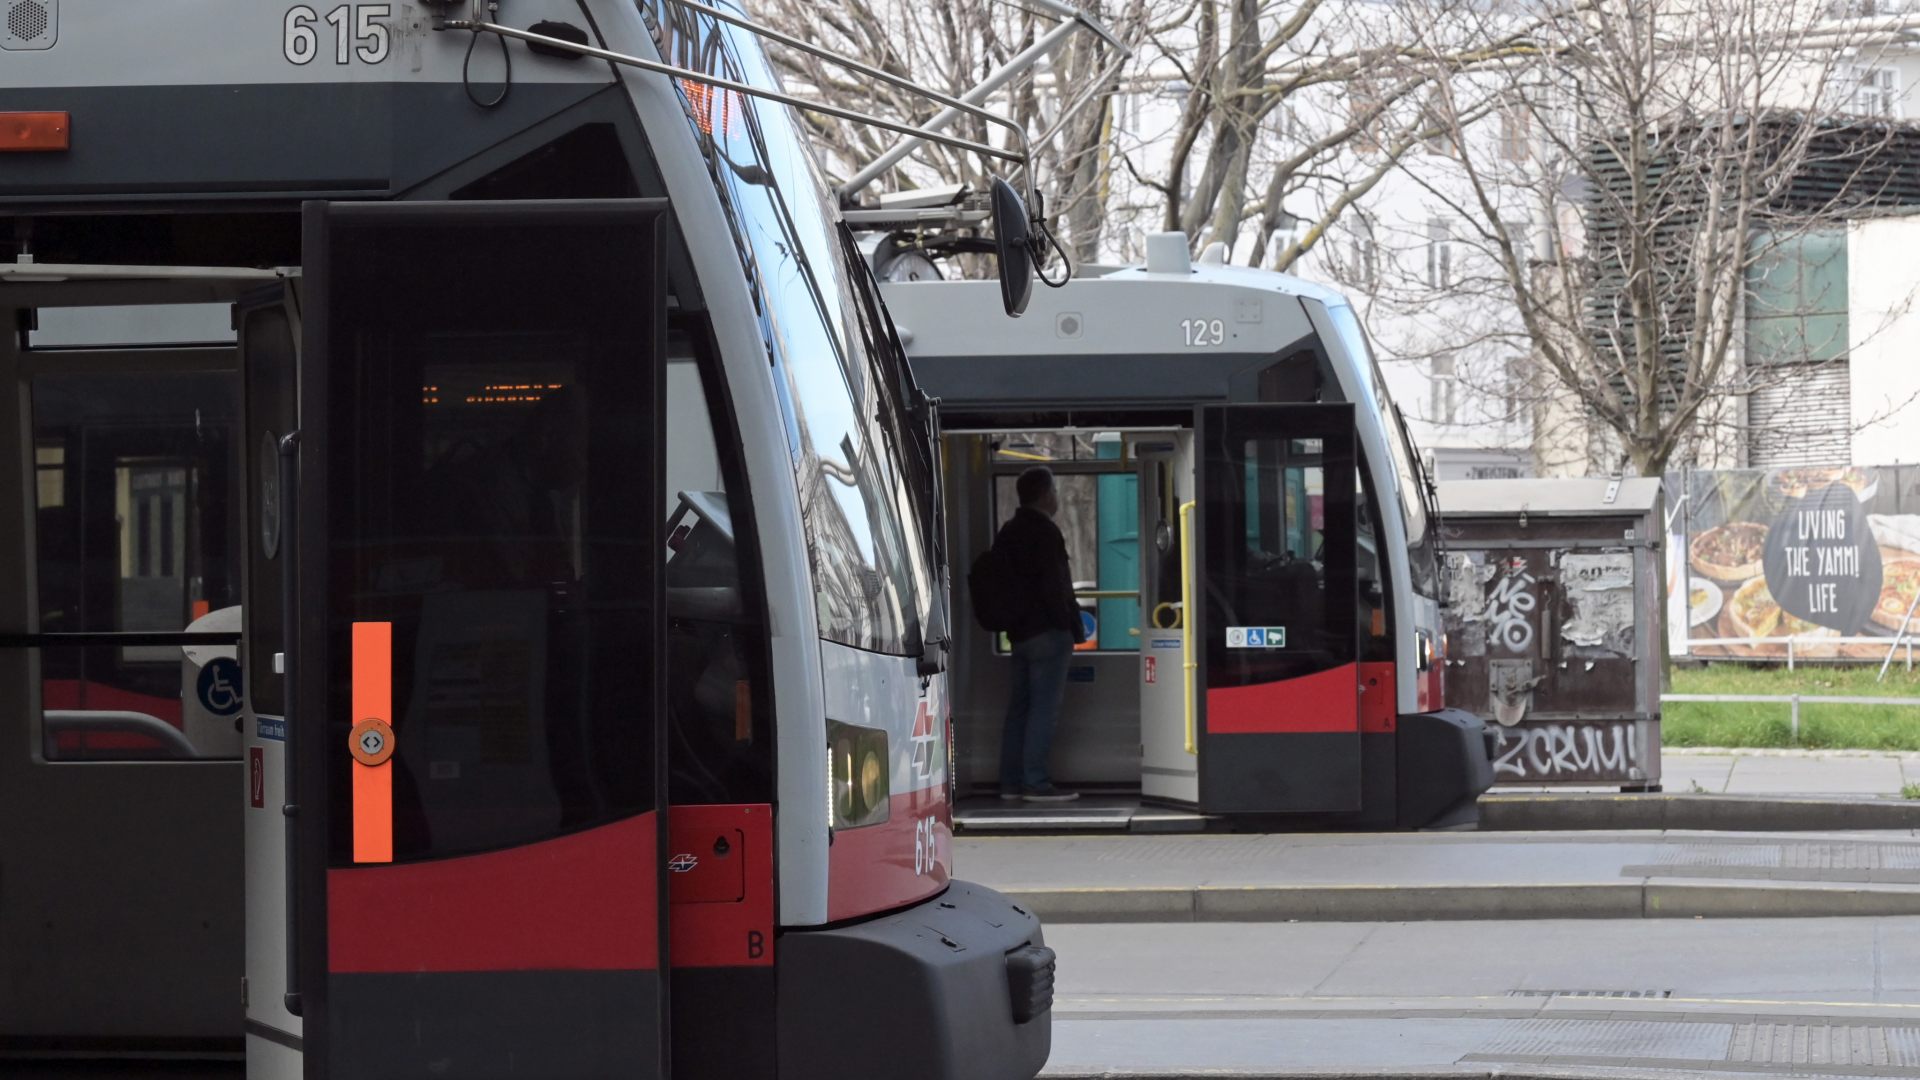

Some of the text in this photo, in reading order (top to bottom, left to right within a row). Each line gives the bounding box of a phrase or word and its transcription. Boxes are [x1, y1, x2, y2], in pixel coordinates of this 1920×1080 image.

[283, 4, 391, 66] 615
[1180, 318, 1225, 346] 129
[1798, 509, 1846, 540] LIVING
[1784, 545, 1860, 578] THE YAMM!
[1808, 583, 1839, 613] LIFE
[915, 815, 936, 876] 615
[747, 930, 764, 959] B
